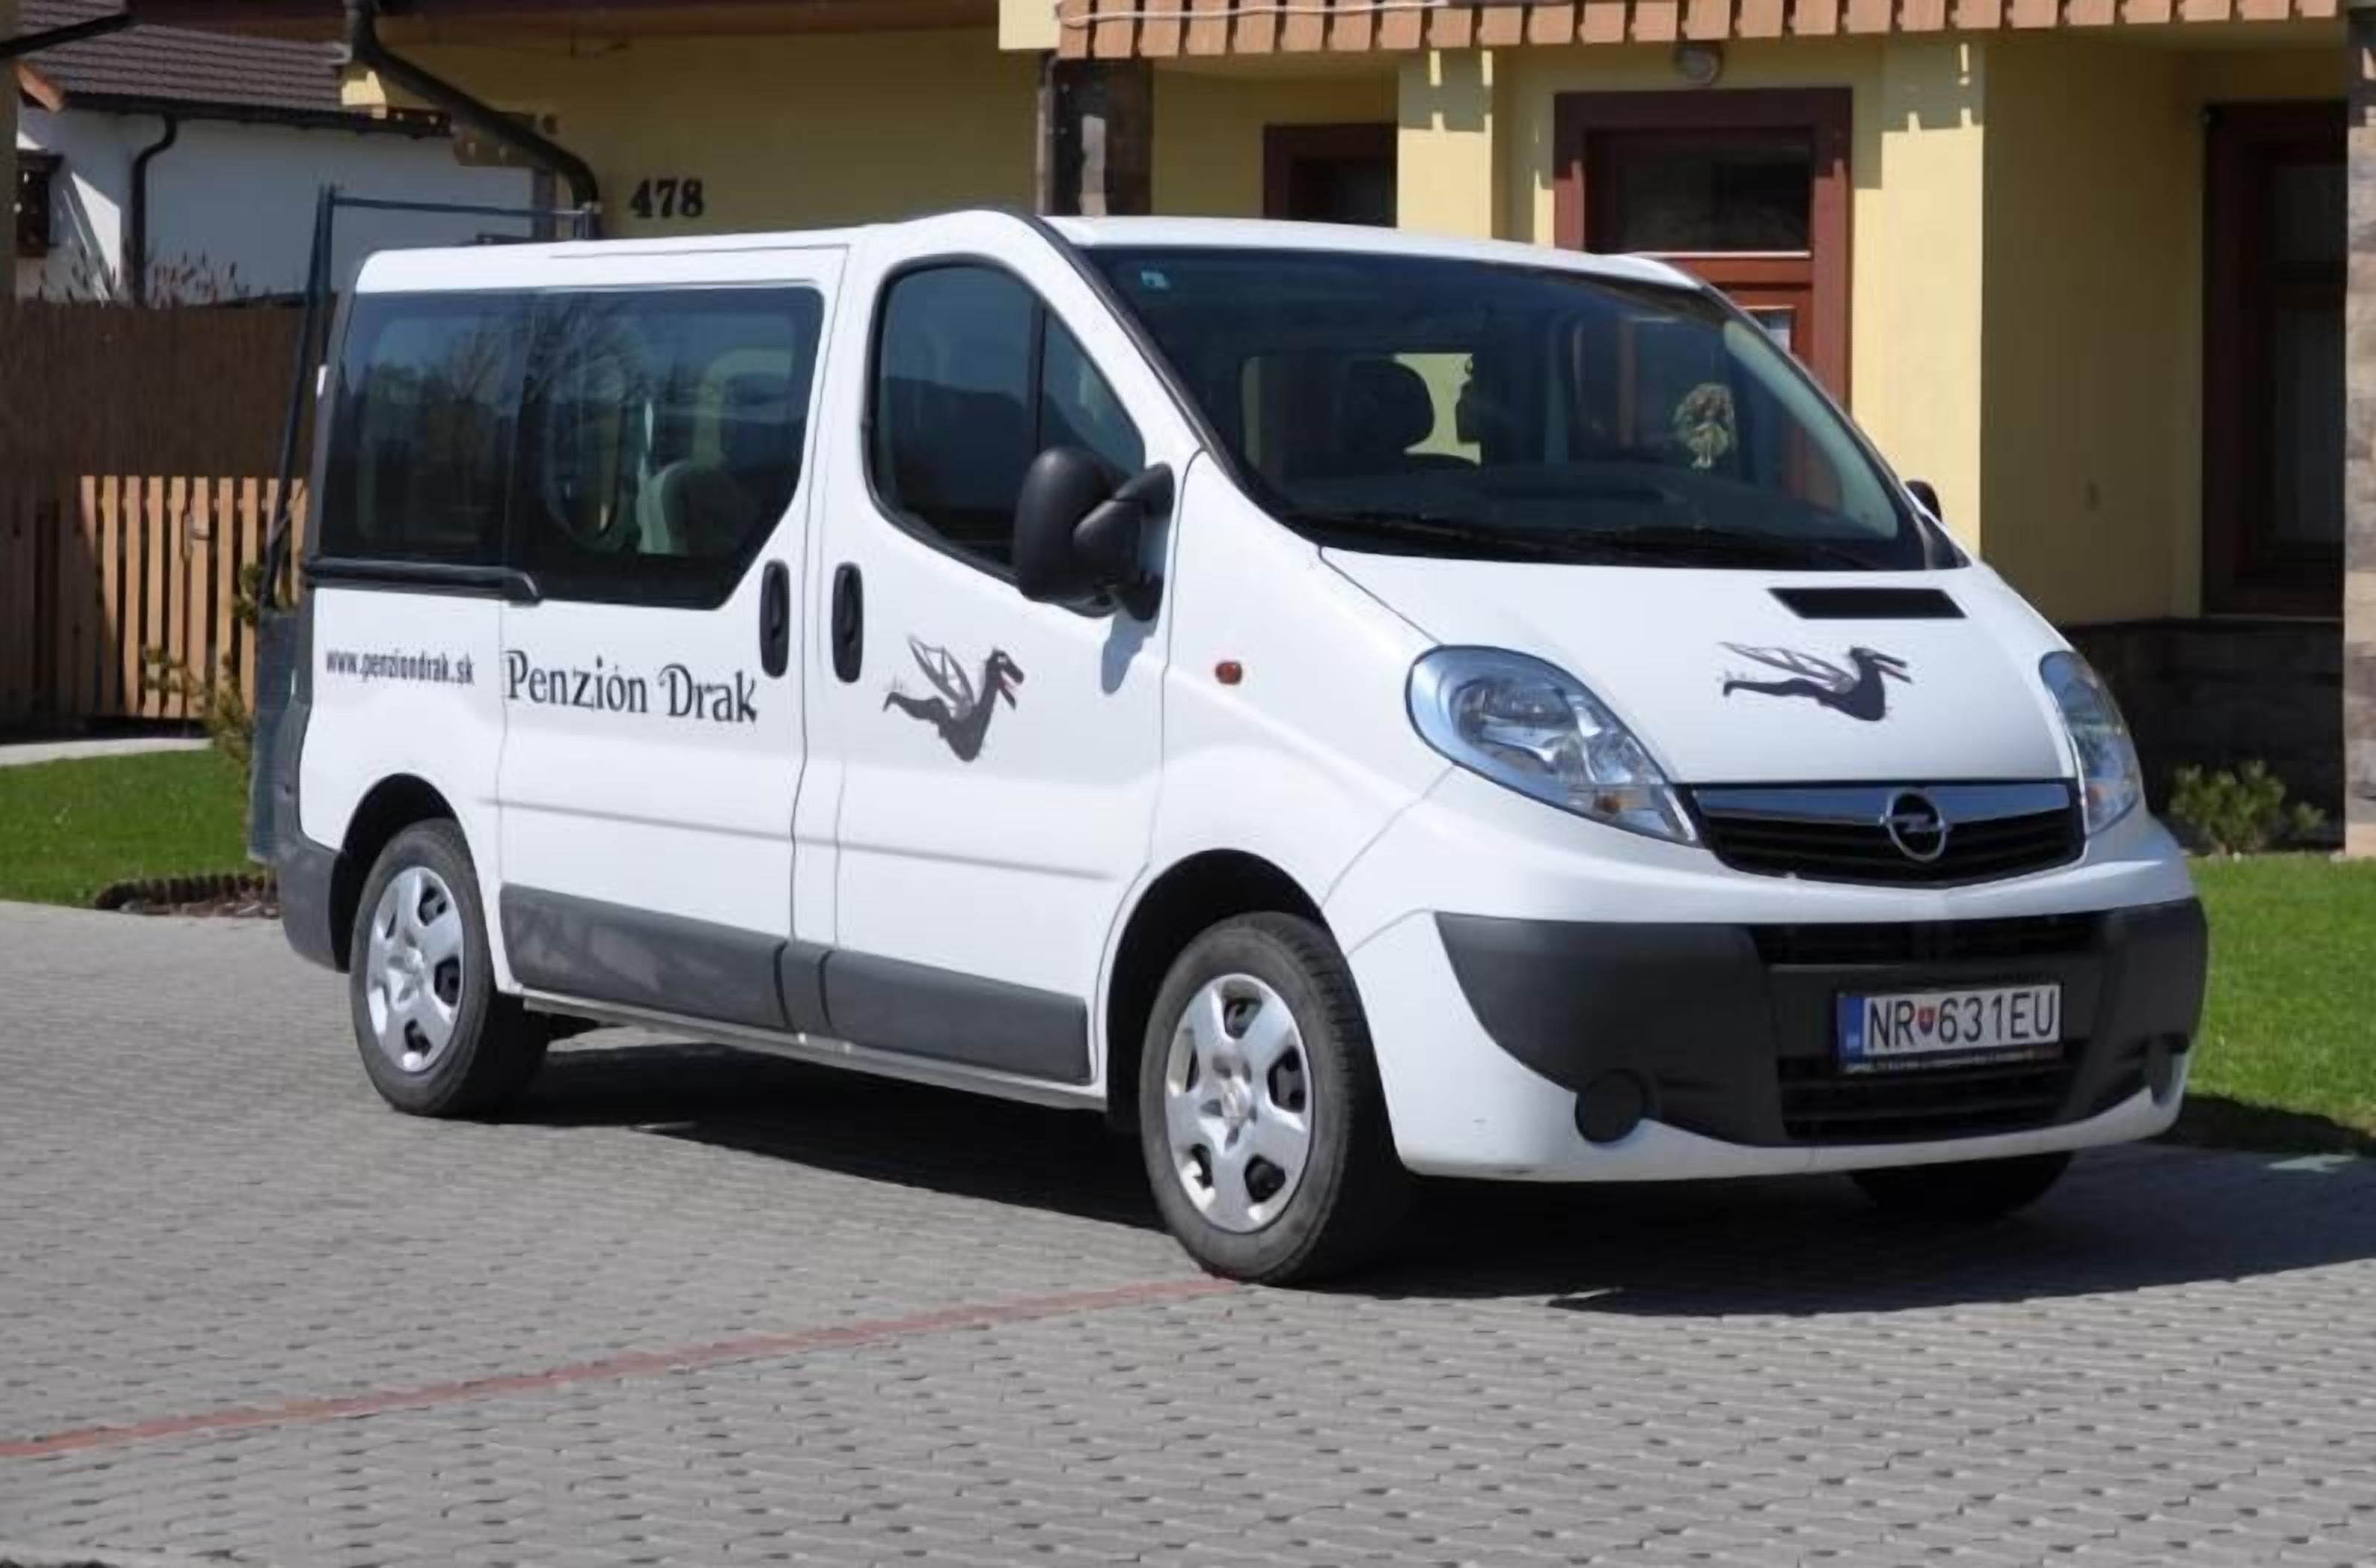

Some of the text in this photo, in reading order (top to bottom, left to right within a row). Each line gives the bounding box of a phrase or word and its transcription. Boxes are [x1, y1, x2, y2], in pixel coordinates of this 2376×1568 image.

[629, 177, 703, 219] 478
[326, 648, 474, 686] www.penziondrak.sk
[659, 663, 757, 723] Drak
